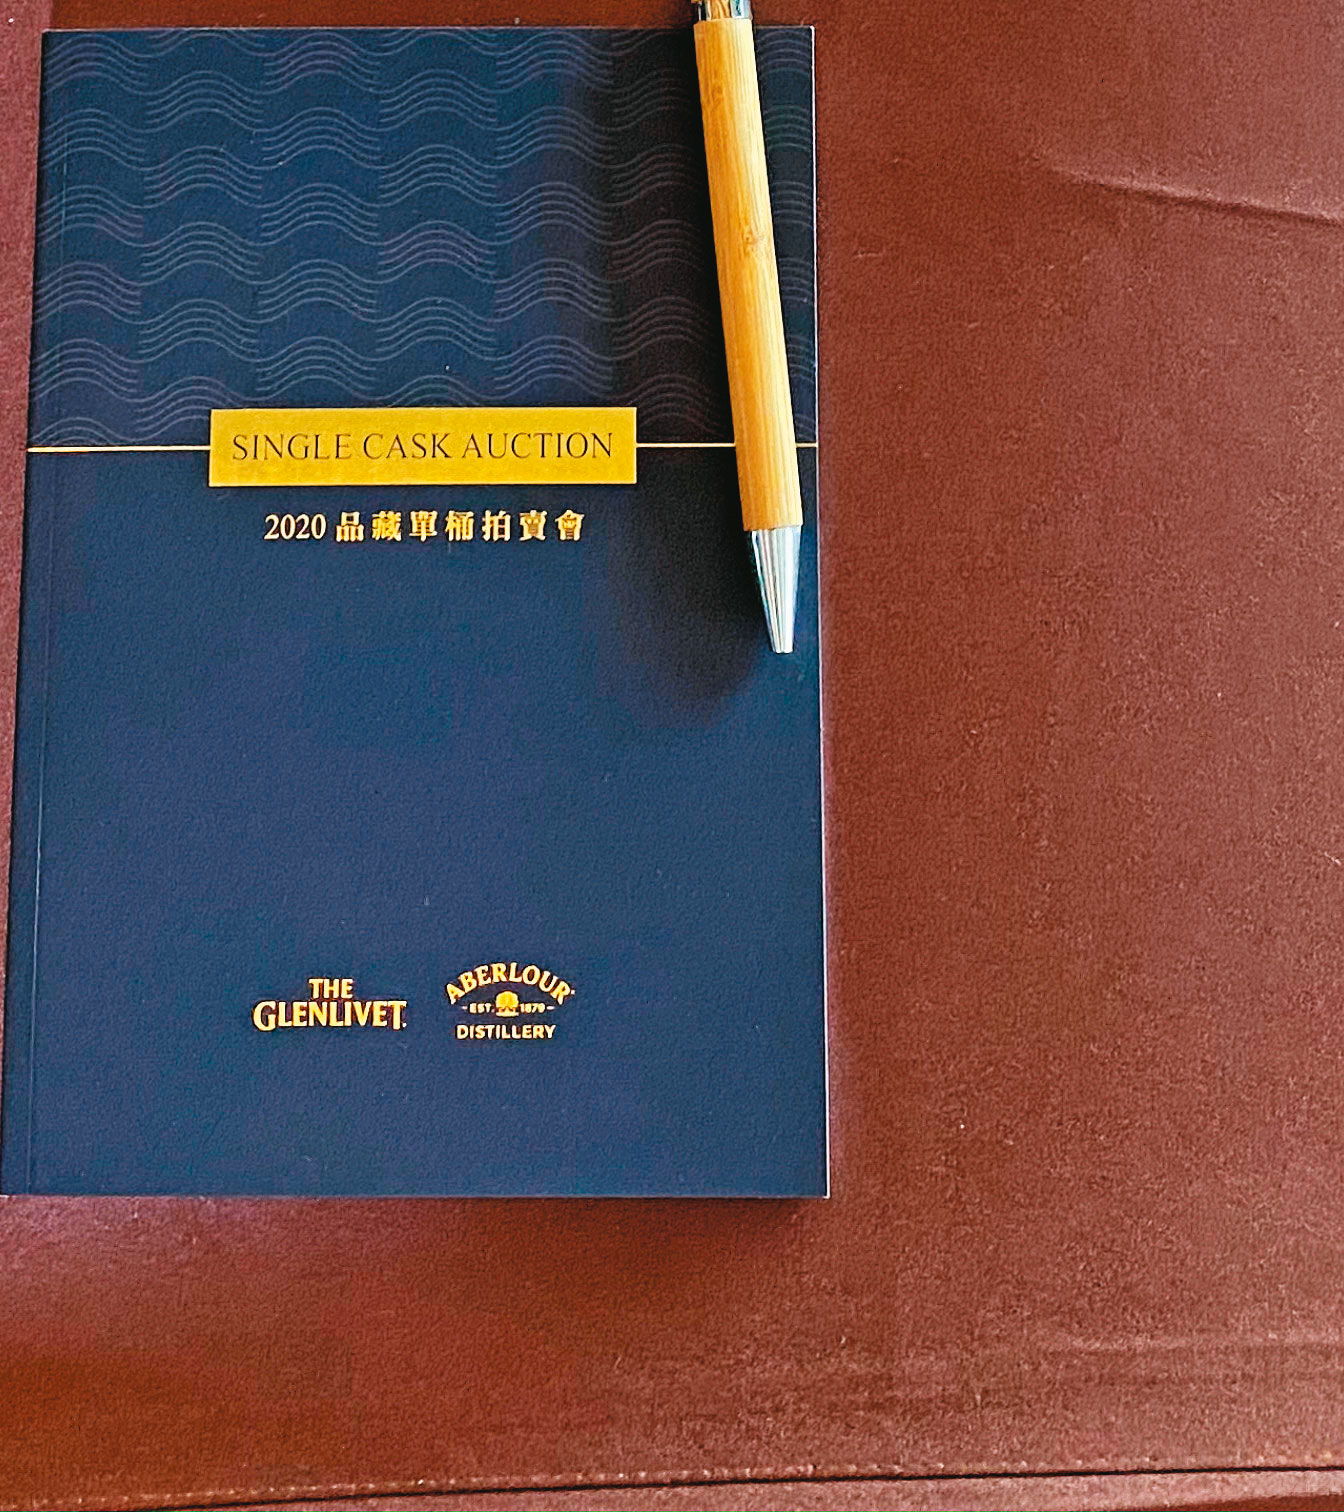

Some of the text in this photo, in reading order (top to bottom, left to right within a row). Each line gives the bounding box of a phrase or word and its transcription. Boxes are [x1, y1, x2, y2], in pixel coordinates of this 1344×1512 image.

[231, 431, 613, 461] SINGLE CASK AUCTION
[263, 509, 586, 543] 2020 品藏單桶拍賣會
[308, 978, 354, 999] THE
[446, 961, 573, 1005] ABERLOUR
[456, 1023, 557, 1040] DISTILLERY
